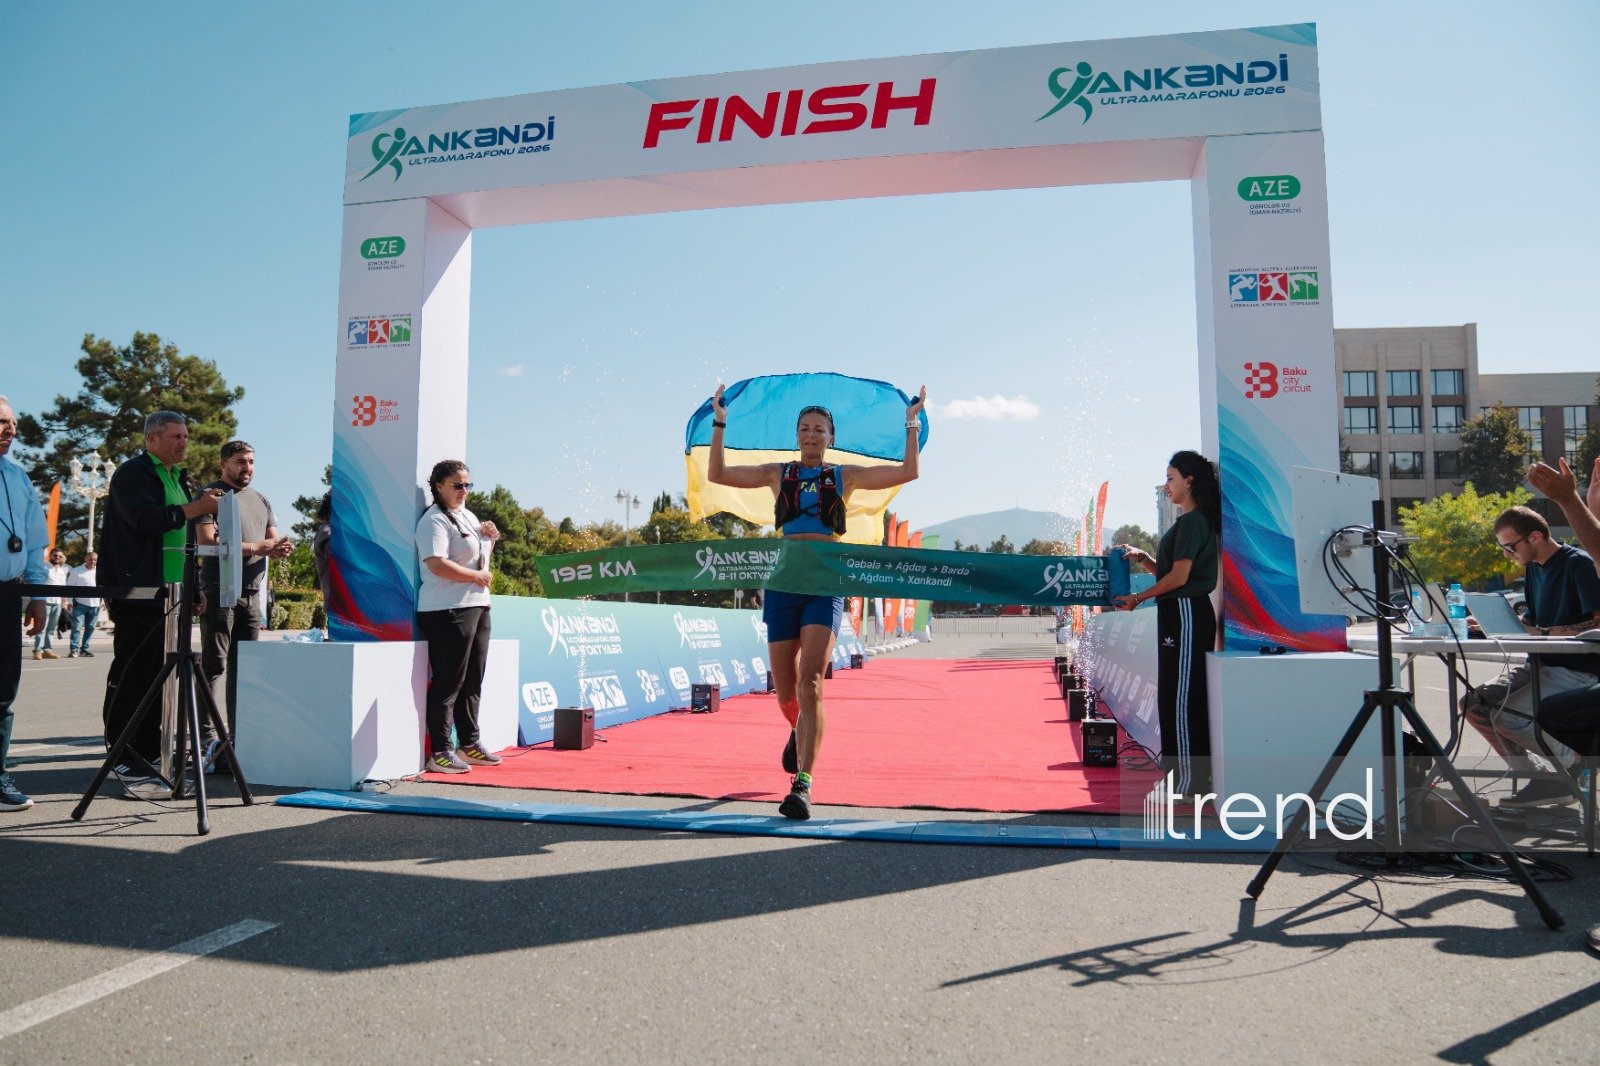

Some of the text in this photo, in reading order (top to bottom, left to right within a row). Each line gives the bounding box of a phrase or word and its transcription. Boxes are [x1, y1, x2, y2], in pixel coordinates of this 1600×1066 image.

[1100, 85, 1286, 106] ULTRAMARAFONU 2026
[643, 78, 937, 148] FINISH
[408, 143, 551, 166] ULTRAMARAFONU 2026
[1248, 179, 1290, 197] AZE
[367, 239, 398, 256] AZE
[1282, 366, 1307, 376] Baku
[1282, 376, 1300, 386] city
[1282, 384, 1312, 394] circuit
[550, 559, 637, 584] 192 KM
[718, 572, 737, 580] 8-11
[940, 565, 970, 576] Bərdə
[859, 572, 953, 587] Ağdam Xankəndi
[1062, 589, 1083, 598] 8-11
